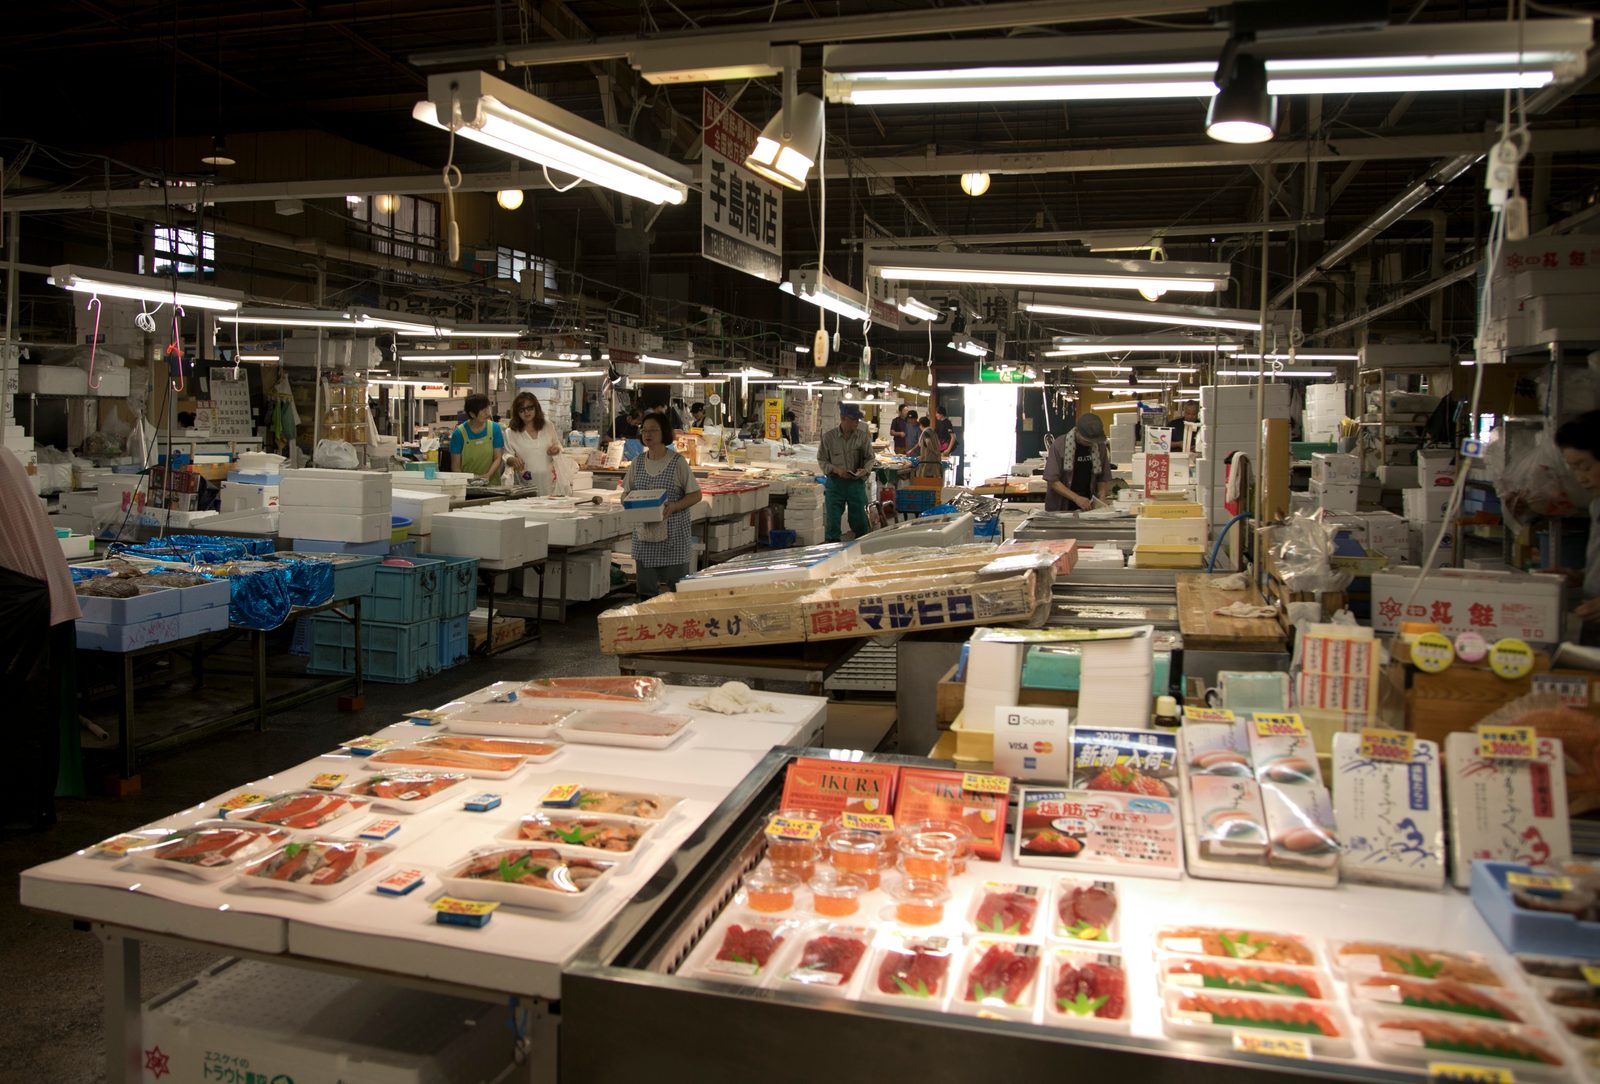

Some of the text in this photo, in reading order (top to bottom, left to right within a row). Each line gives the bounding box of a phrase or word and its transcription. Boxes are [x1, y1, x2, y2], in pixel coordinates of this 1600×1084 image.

[709, 158, 778, 248] 手島商店
[858, 595, 974, 630] マルヒロ
[1430, 600, 1497, 628] 紅鮭
[1022, 716, 1055, 727] Square
[1008, 742, 1028, 750] VISA
[1078, 744, 1118, 768] 新物
[820, 773, 880, 793] IKURA
[1038, 801, 1105, 819] 塩筋子
